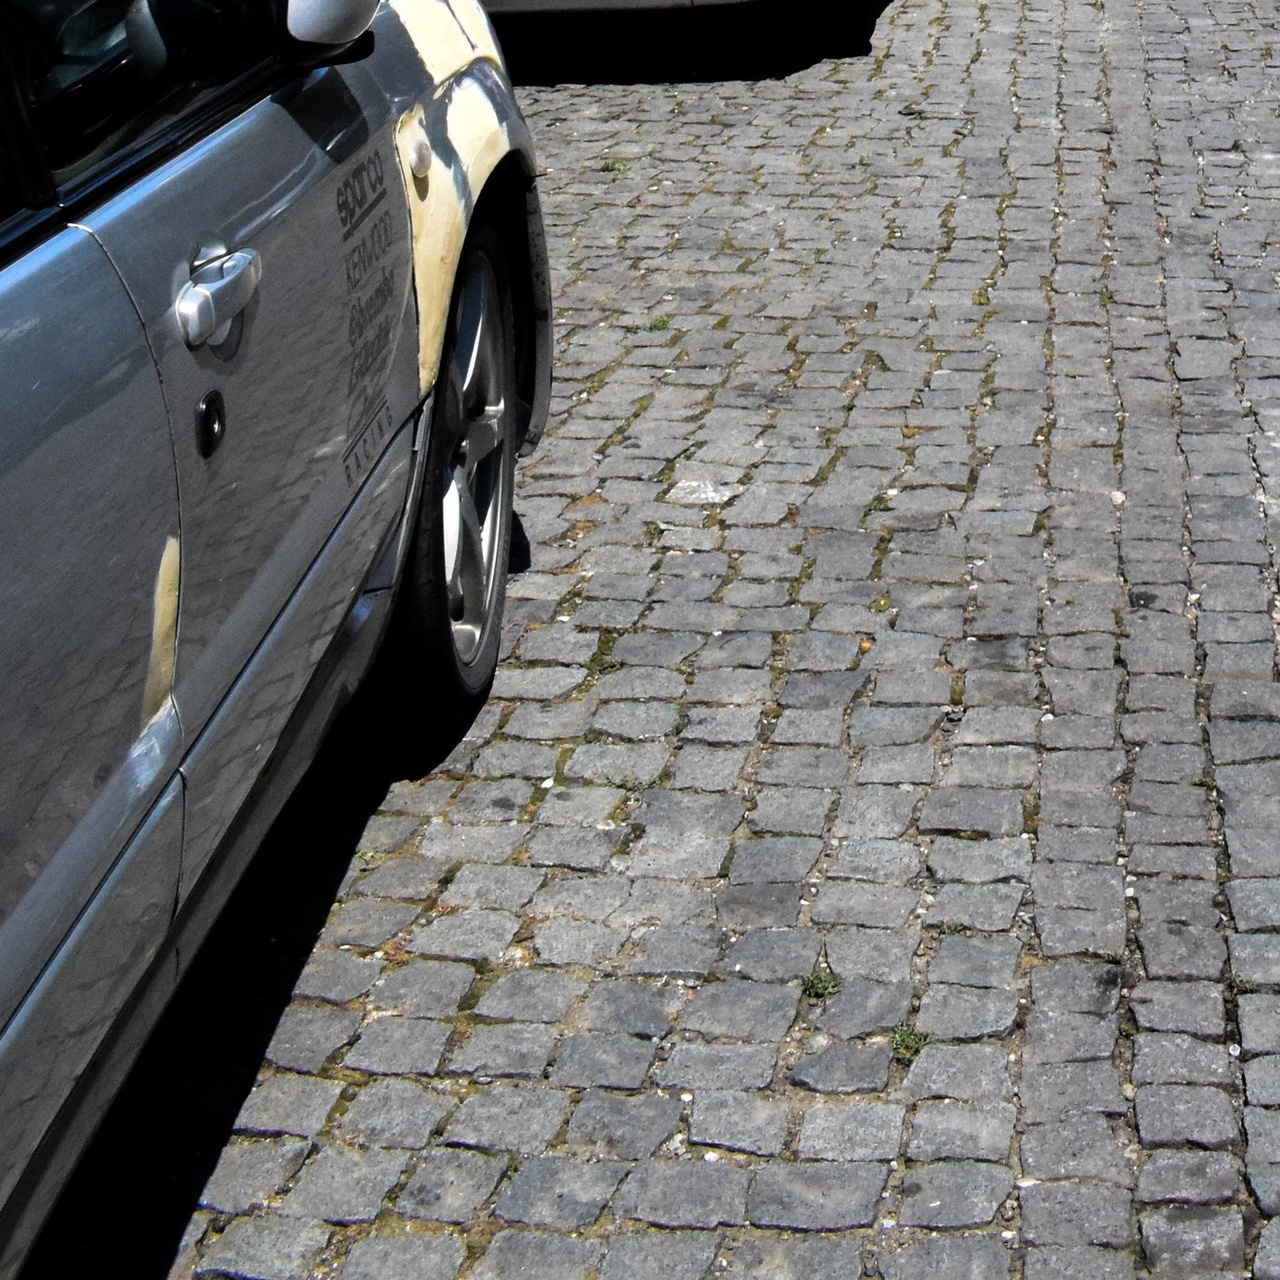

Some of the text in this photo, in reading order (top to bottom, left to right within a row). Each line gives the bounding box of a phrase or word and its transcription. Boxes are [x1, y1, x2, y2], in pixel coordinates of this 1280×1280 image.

[337, 148, 384, 227] sparco
[345, 210, 392, 293] KENWOOD
[345, 405, 393, 487] RACING
